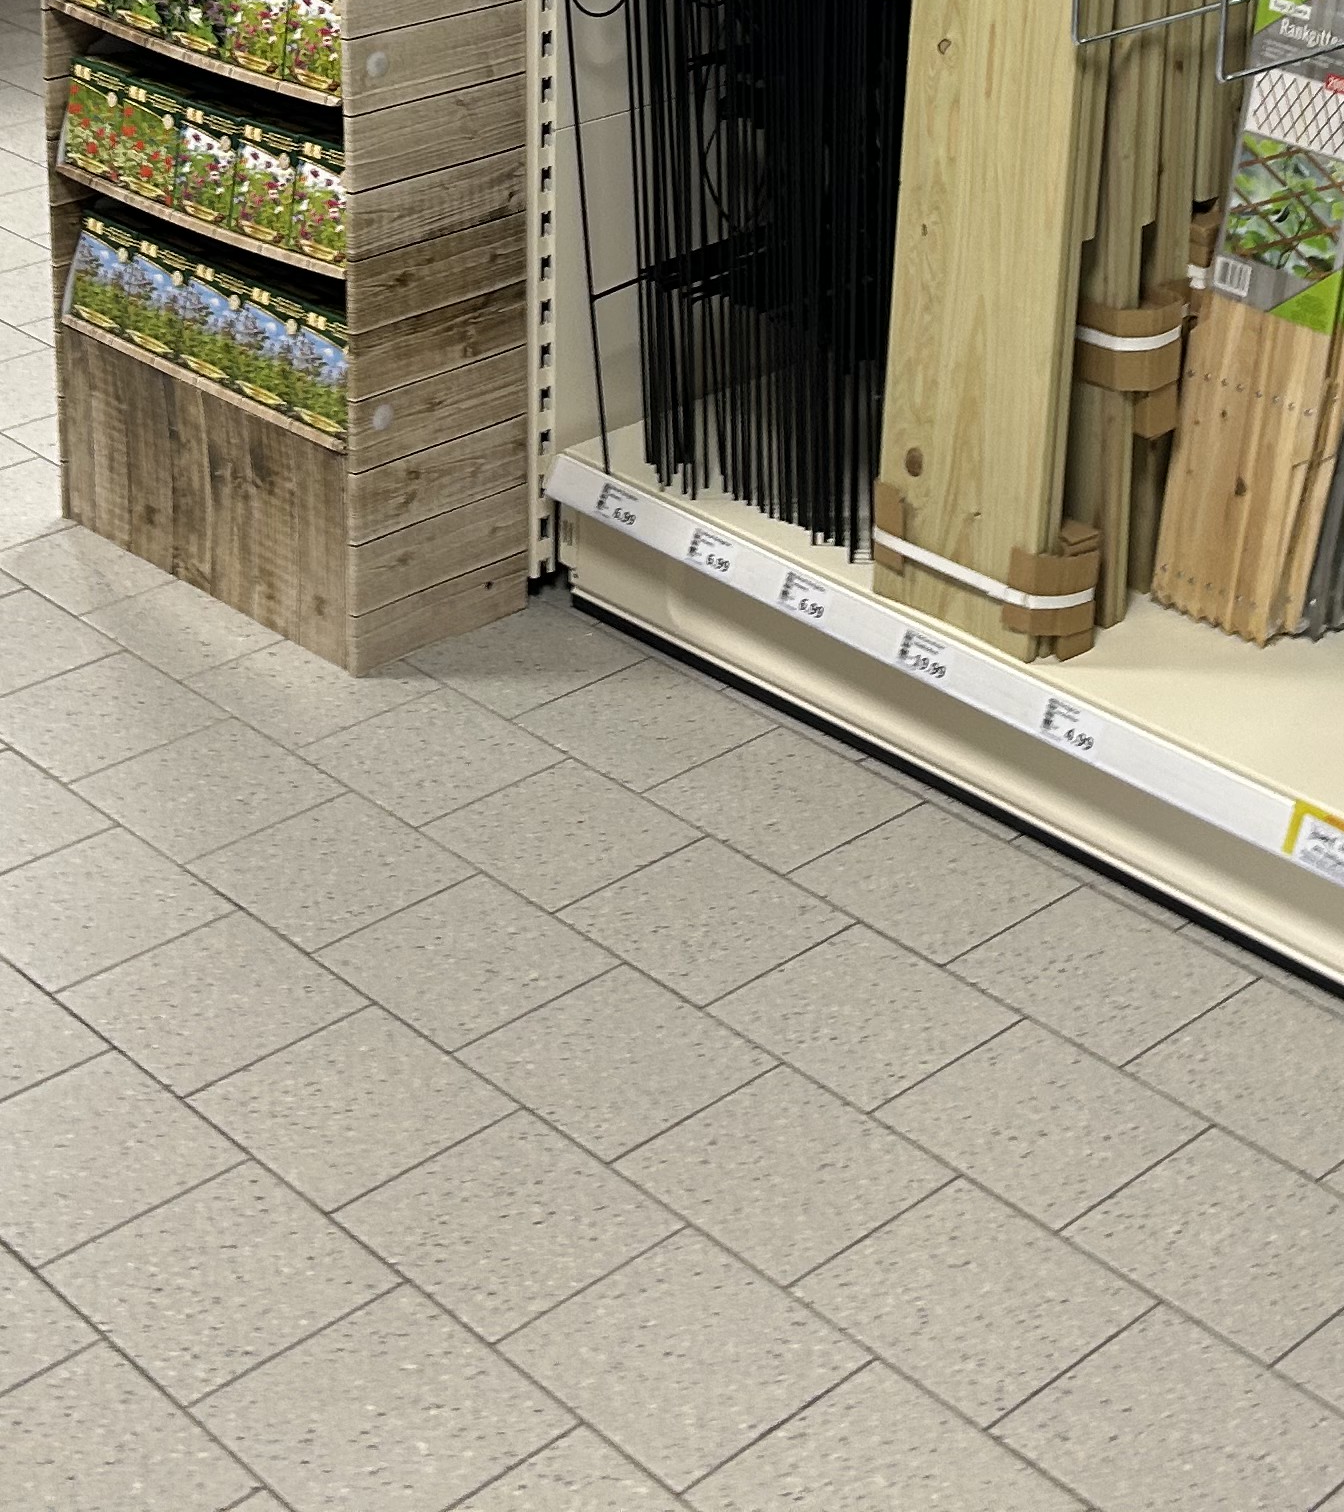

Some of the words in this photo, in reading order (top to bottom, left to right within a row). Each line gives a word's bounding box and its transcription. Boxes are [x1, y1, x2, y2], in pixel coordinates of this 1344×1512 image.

[612, 506, 636, 527] 6.99
[705, 553, 730, 574] 6.99
[799, 597, 824, 619] 6.99
